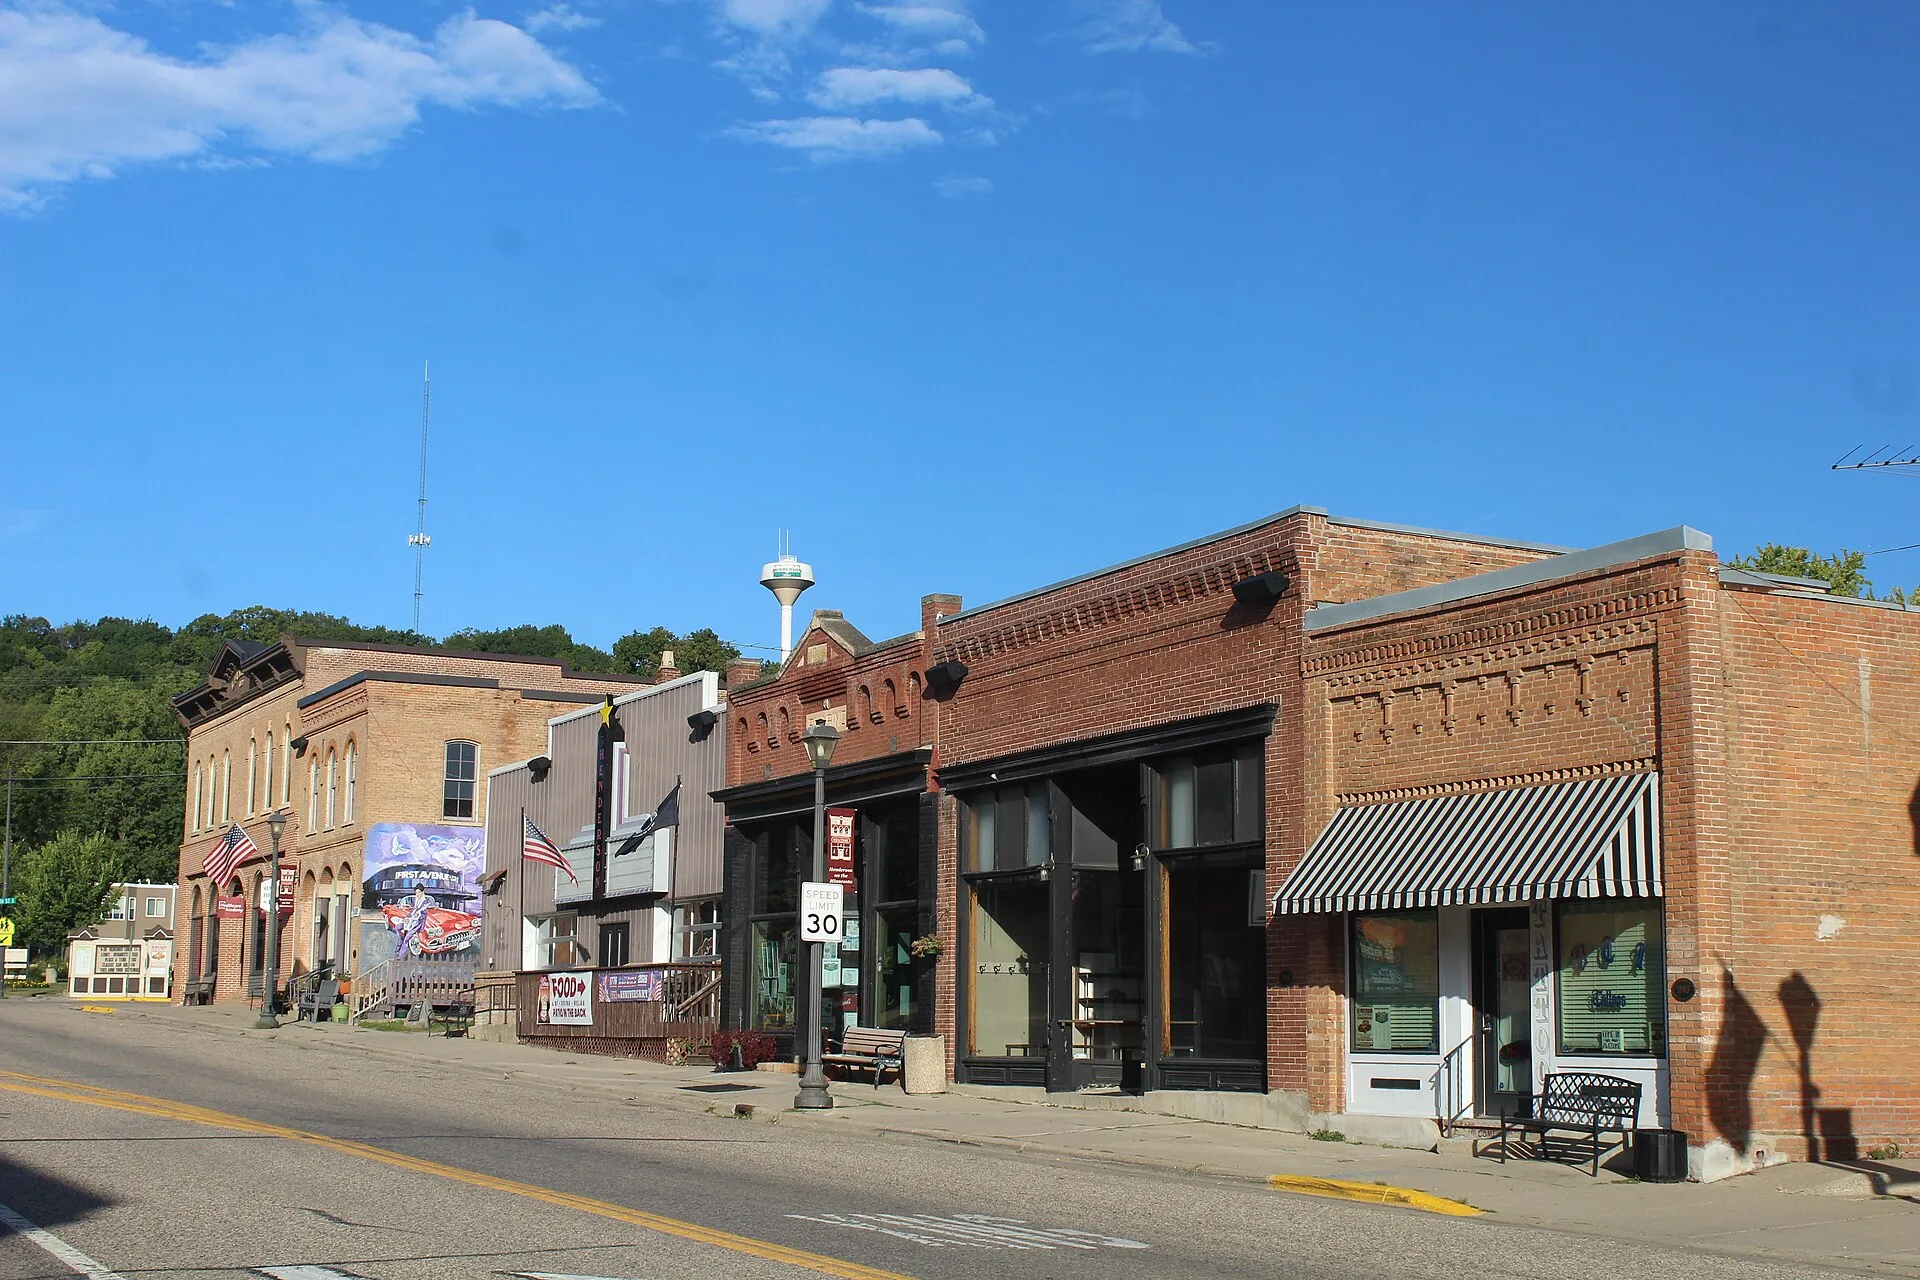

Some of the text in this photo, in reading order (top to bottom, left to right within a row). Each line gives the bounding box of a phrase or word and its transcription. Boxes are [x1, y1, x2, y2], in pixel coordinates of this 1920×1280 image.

[594, 748, 605, 890] HENDERSON
[397, 871, 419, 879] FIRST
[419, 871, 449, 881] AVENUE
[806, 889, 839, 900] SPEED
[809, 902, 835, 911] LIMIT
[806, 913, 837, 935] 30
[551, 976, 577, 998] FOOD
[620, 989, 648, 999] ANNIVERSARY
[574, 1008, 587, 1018] BACK
[784, 1213, 1151, 1249] XING
